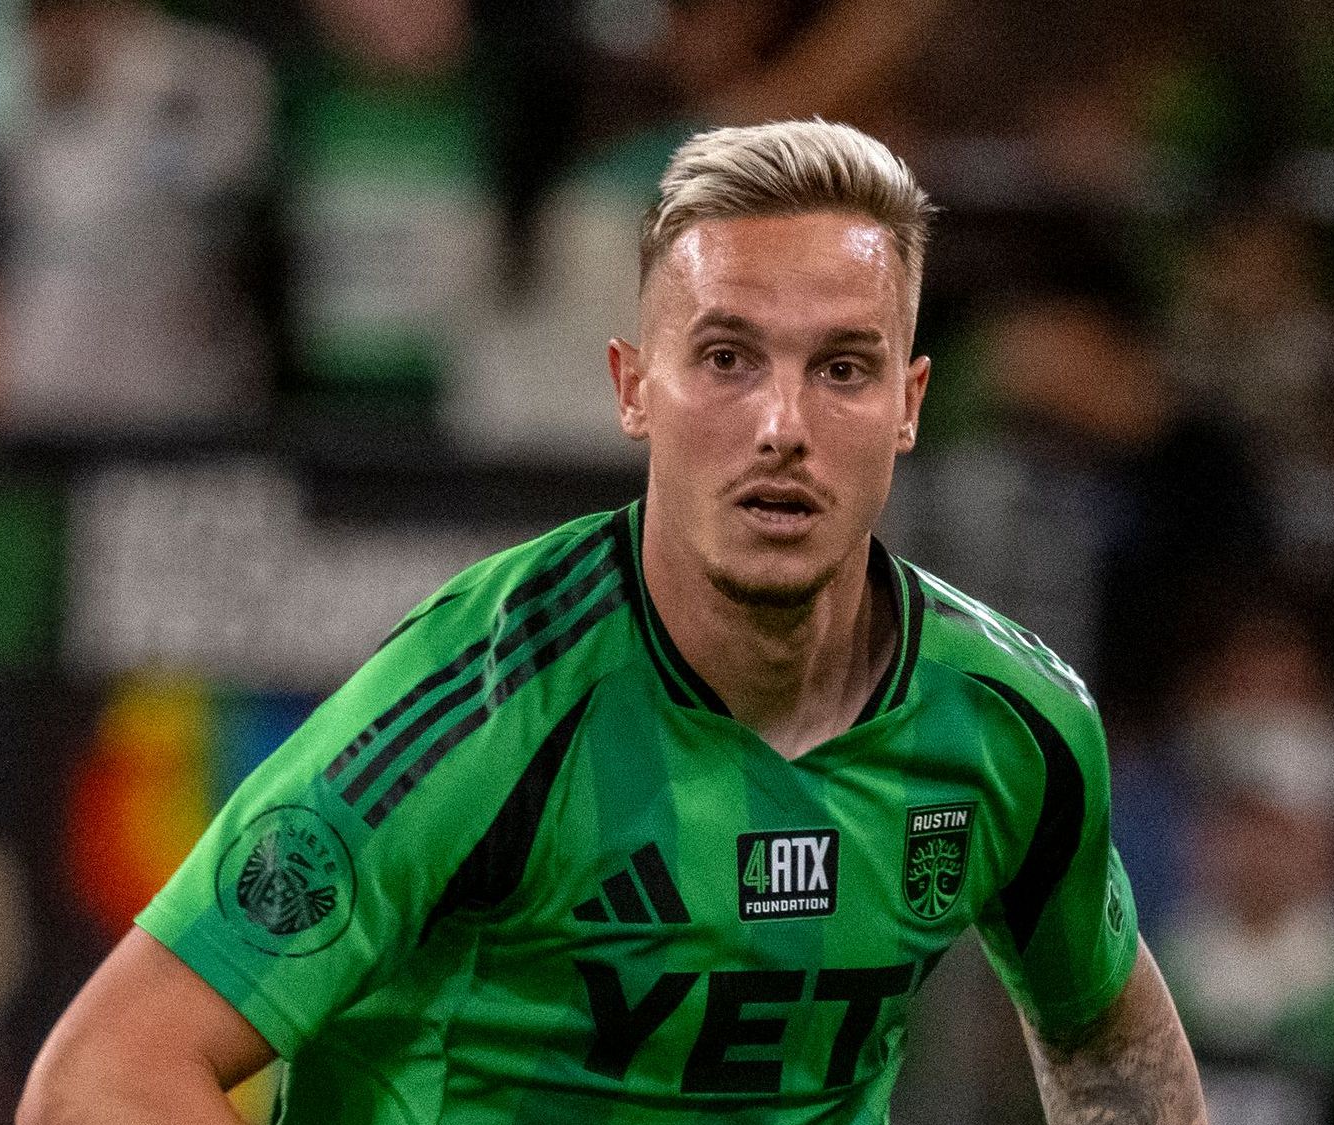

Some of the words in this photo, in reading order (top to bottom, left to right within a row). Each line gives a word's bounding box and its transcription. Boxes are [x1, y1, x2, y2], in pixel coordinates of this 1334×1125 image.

[912, 810, 968, 831] AUSTIN
[746, 898, 829, 914] FOUNDATION
[575, 953, 942, 1094] YET
